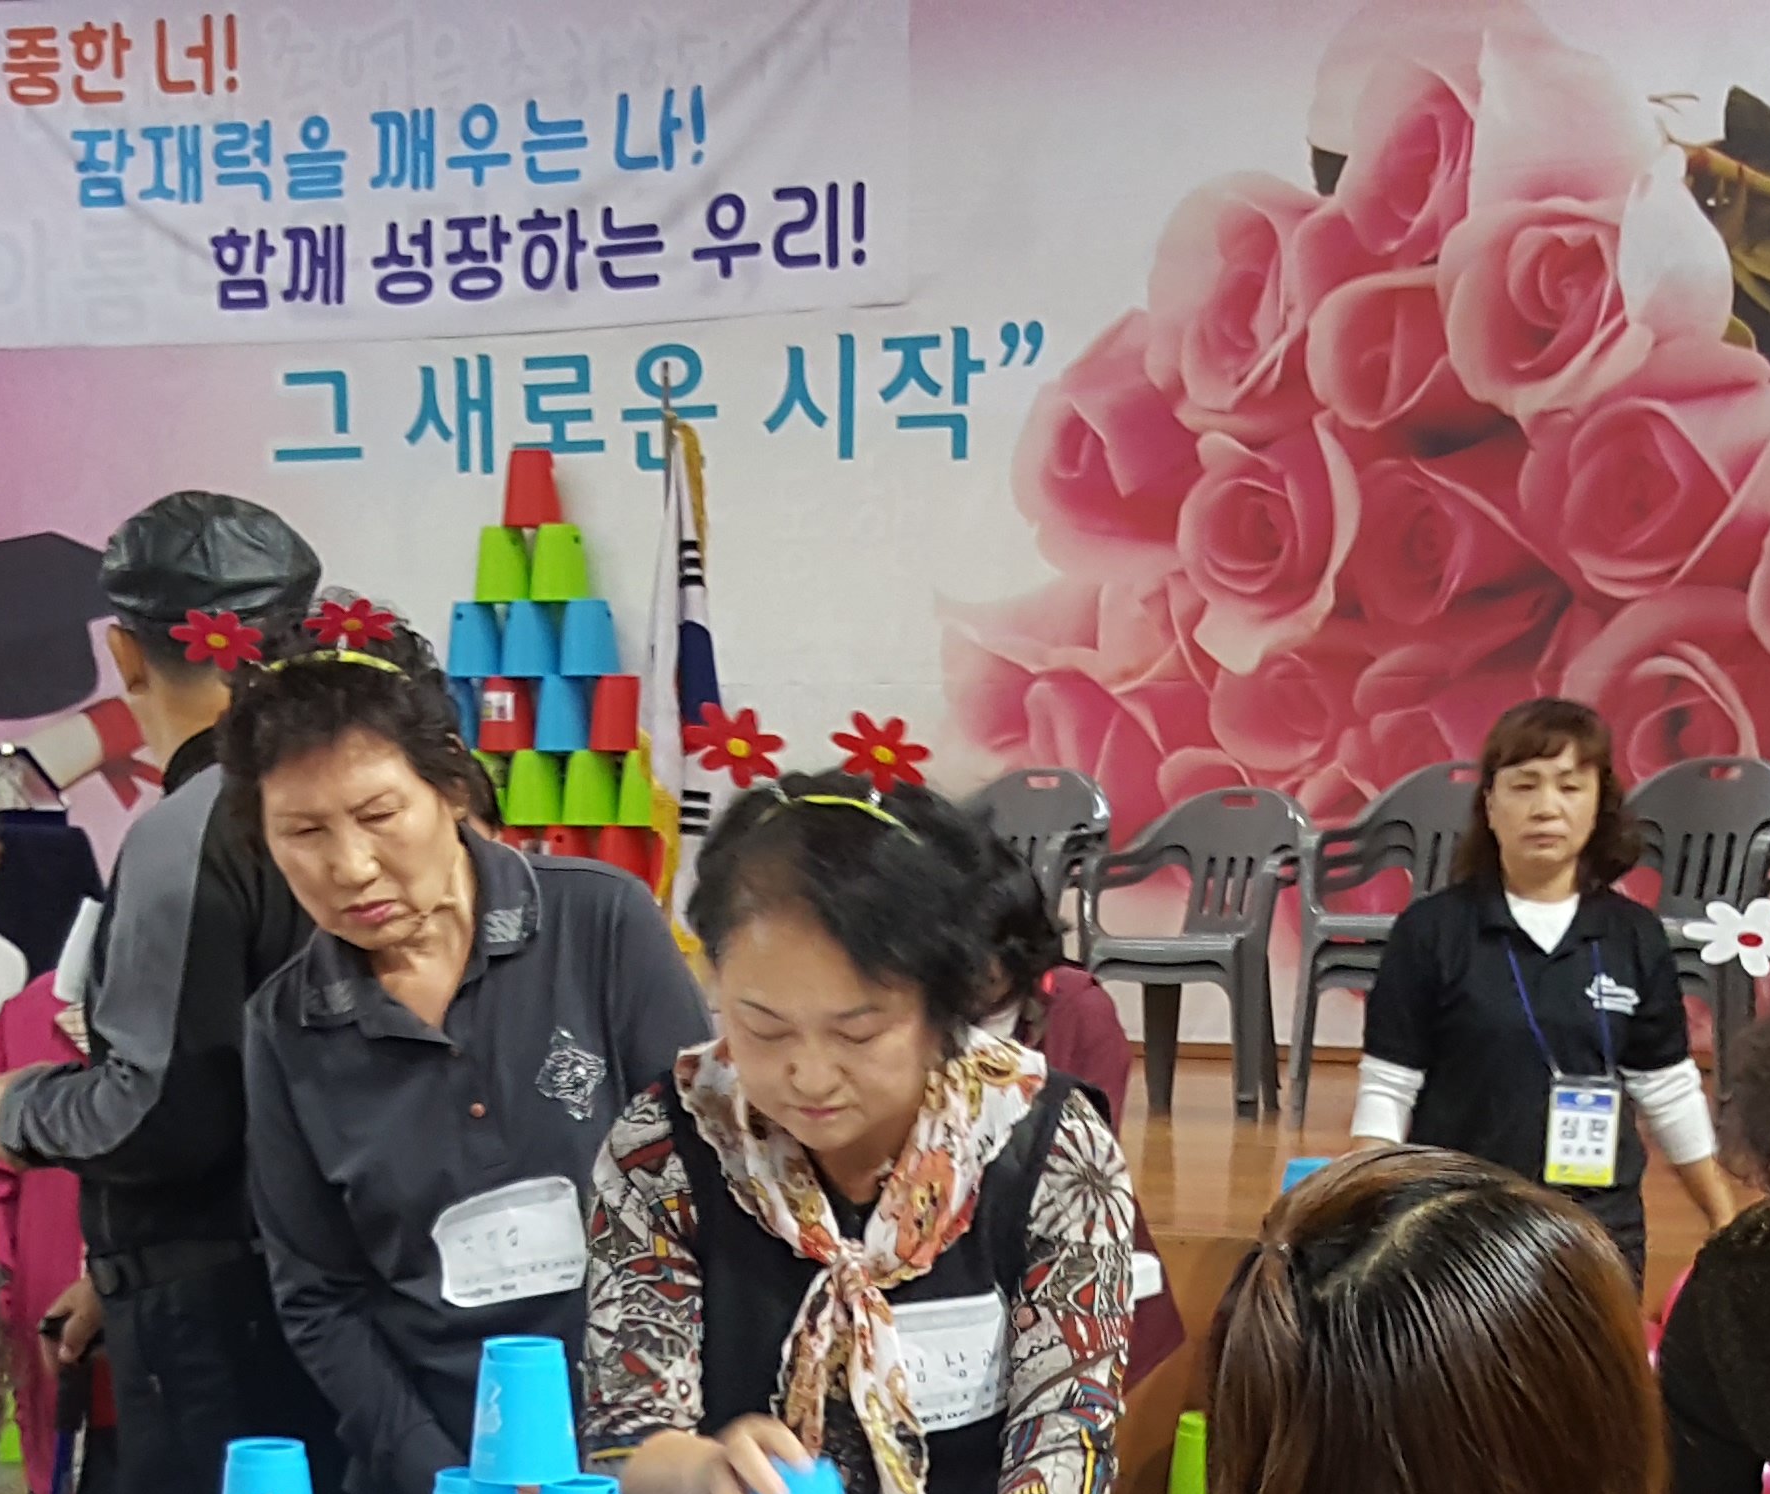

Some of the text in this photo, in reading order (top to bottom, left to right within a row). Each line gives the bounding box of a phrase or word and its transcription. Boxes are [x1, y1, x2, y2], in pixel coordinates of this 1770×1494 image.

[154, 13, 240, 96] 너!
[70, 84, 707, 208] 잠재력을 깨우는 나!
[209, 180, 868, 311] 함께 성장하는 우리!
[273, 368, 364, 463] 그
[404, 342, 719, 475] 새로운
